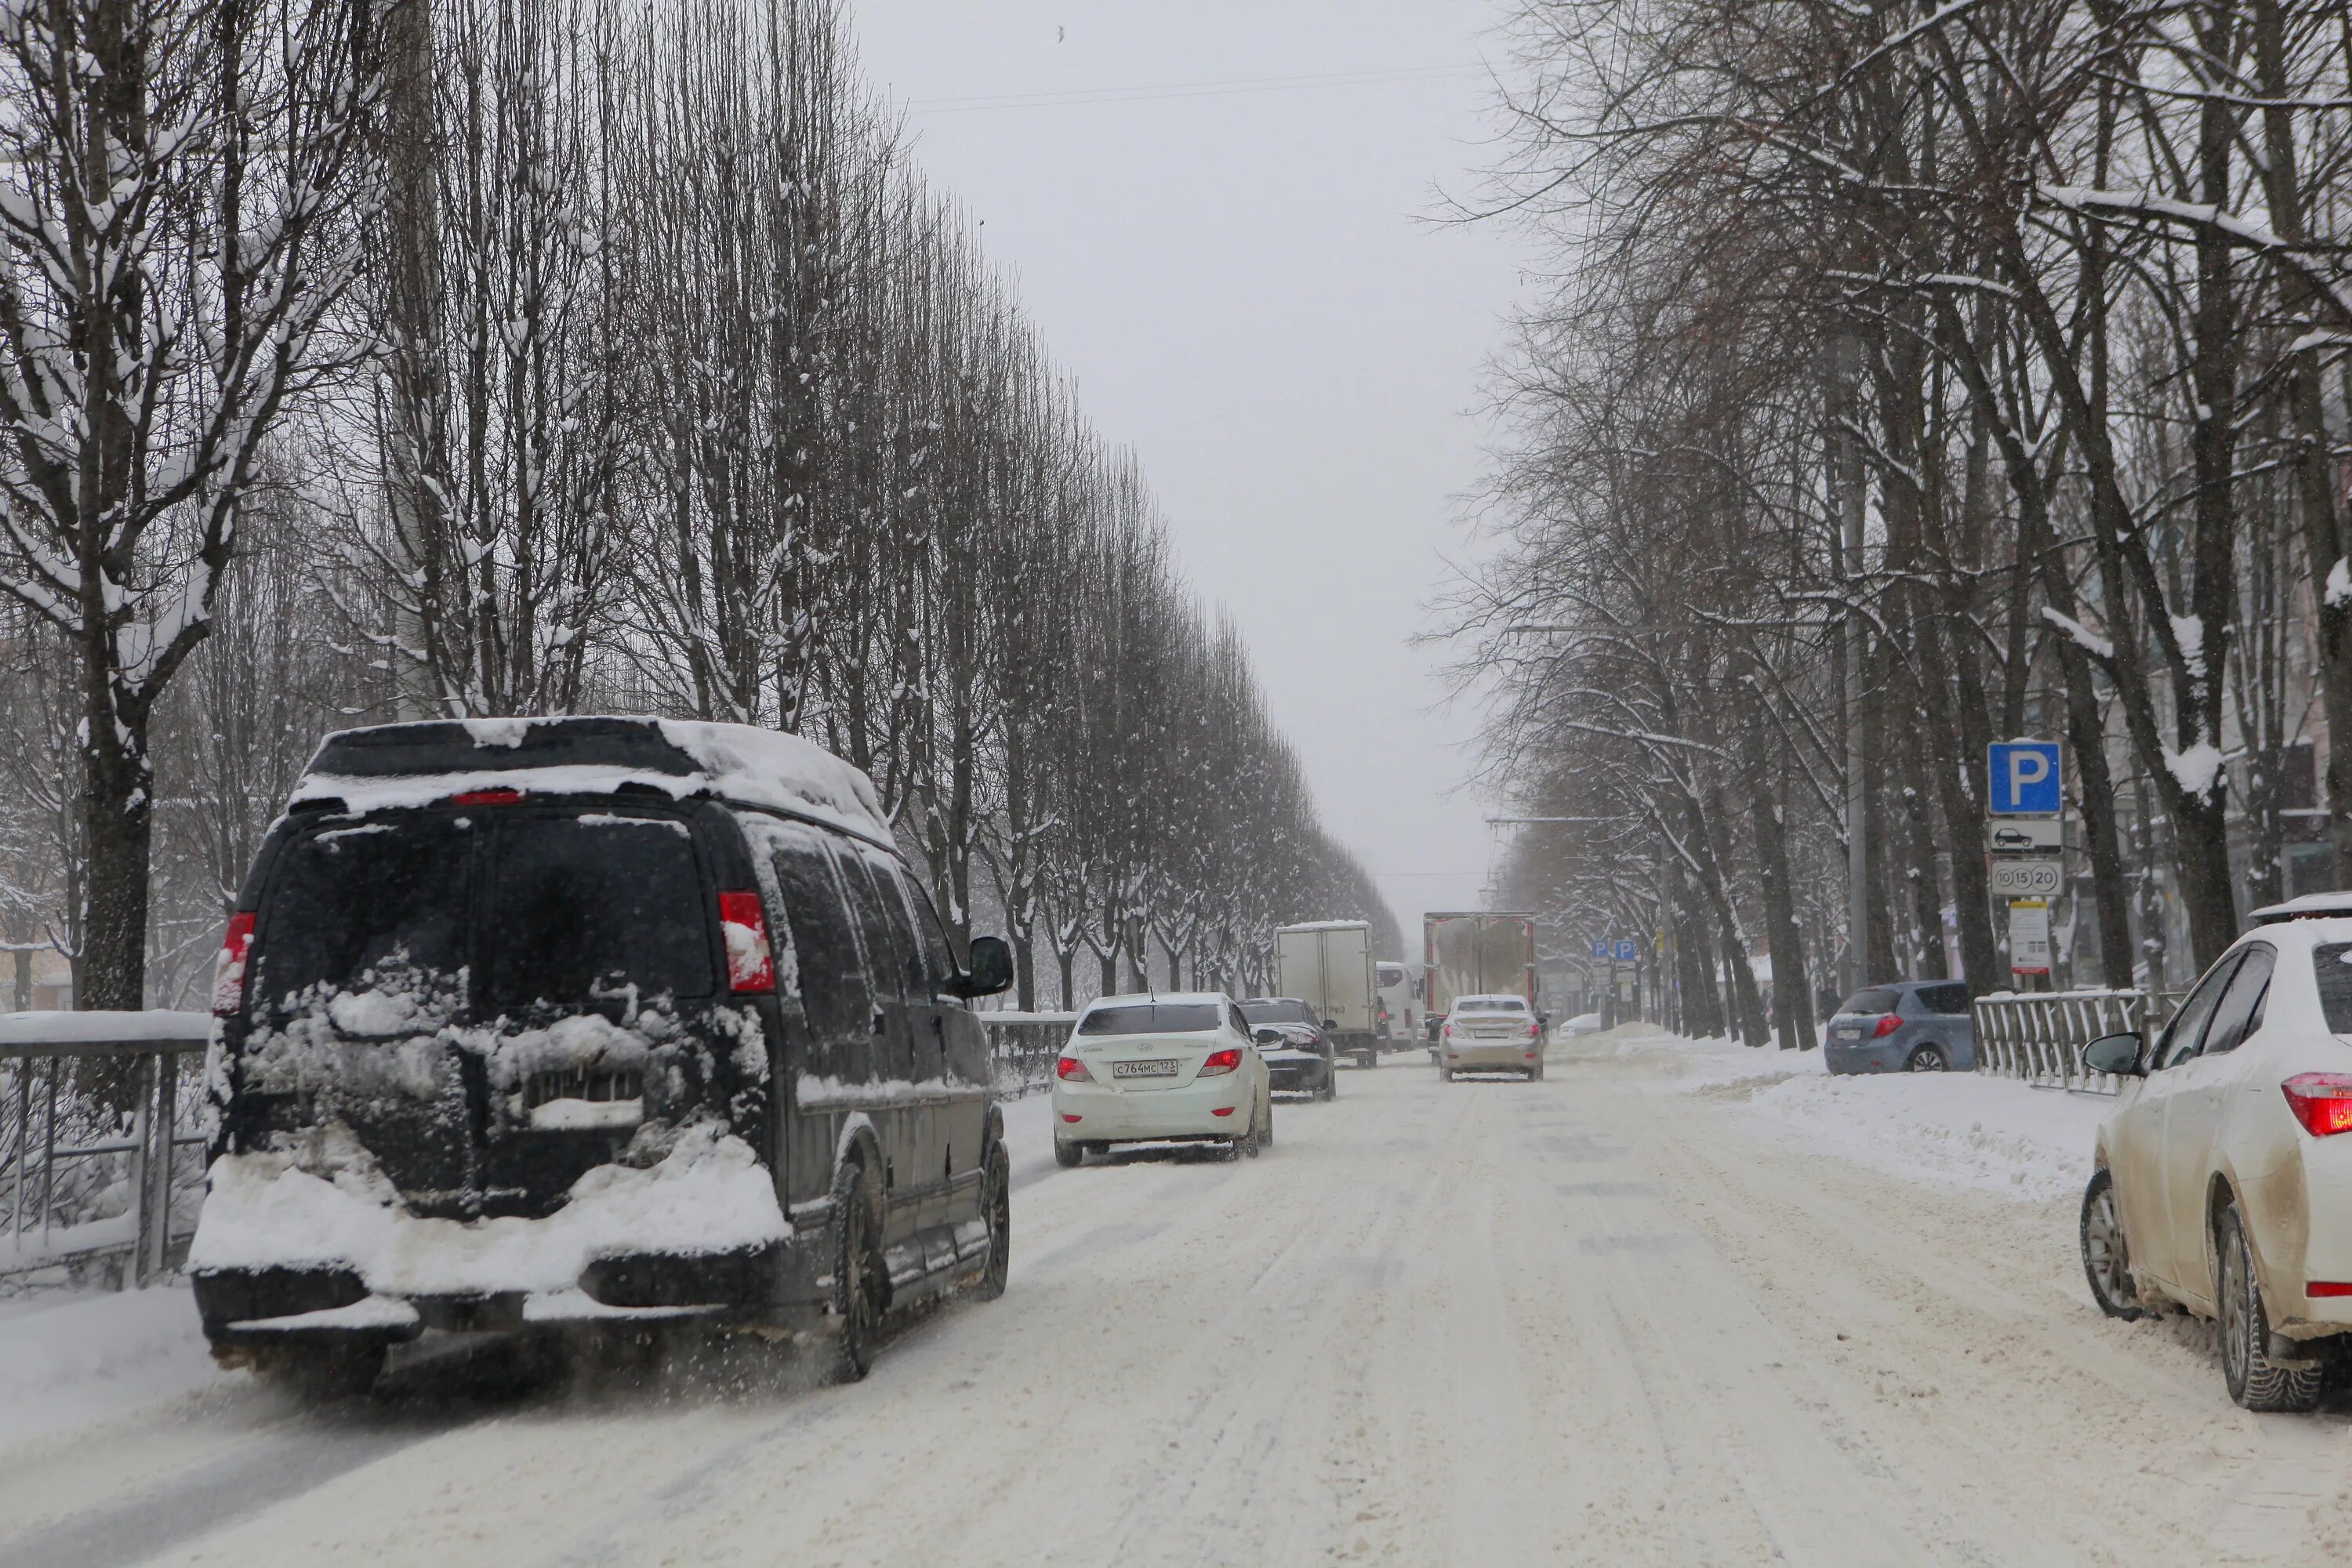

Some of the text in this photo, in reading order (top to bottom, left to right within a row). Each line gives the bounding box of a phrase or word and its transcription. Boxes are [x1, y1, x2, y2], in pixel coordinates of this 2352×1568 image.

[2009, 750, 2049, 806] P
[1999, 871, 2053, 884] 10 15 20
[1595, 942, 1606, 956] P
[1620, 942, 1632, 958] P
[1159, 1061, 1174, 1069] 123
